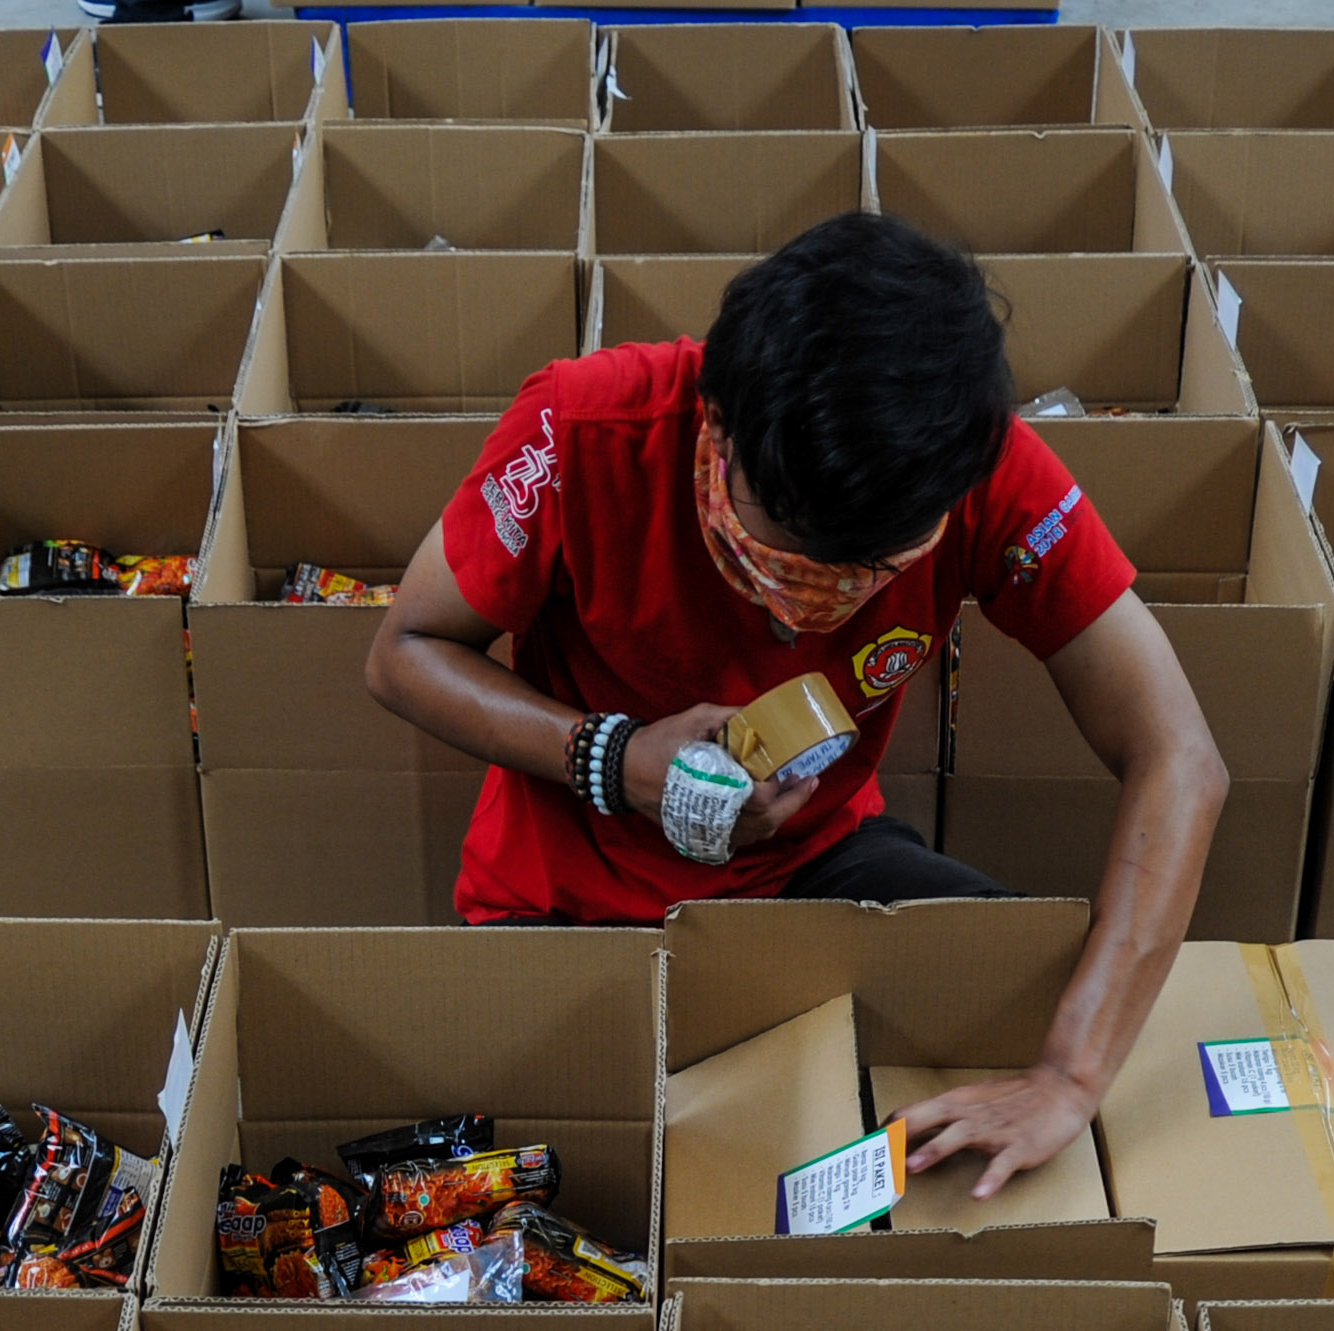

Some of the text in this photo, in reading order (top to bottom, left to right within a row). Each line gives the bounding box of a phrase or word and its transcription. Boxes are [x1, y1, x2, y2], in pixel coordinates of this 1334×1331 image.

[505, 513, 528, 548] KITA
[1026, 508, 1063, 548] ASIAN
[1034, 526, 1065, 558] 2018
[801, 752, 822, 769] TAPE
[874, 1145, 886, 1191] ISI PAKET
